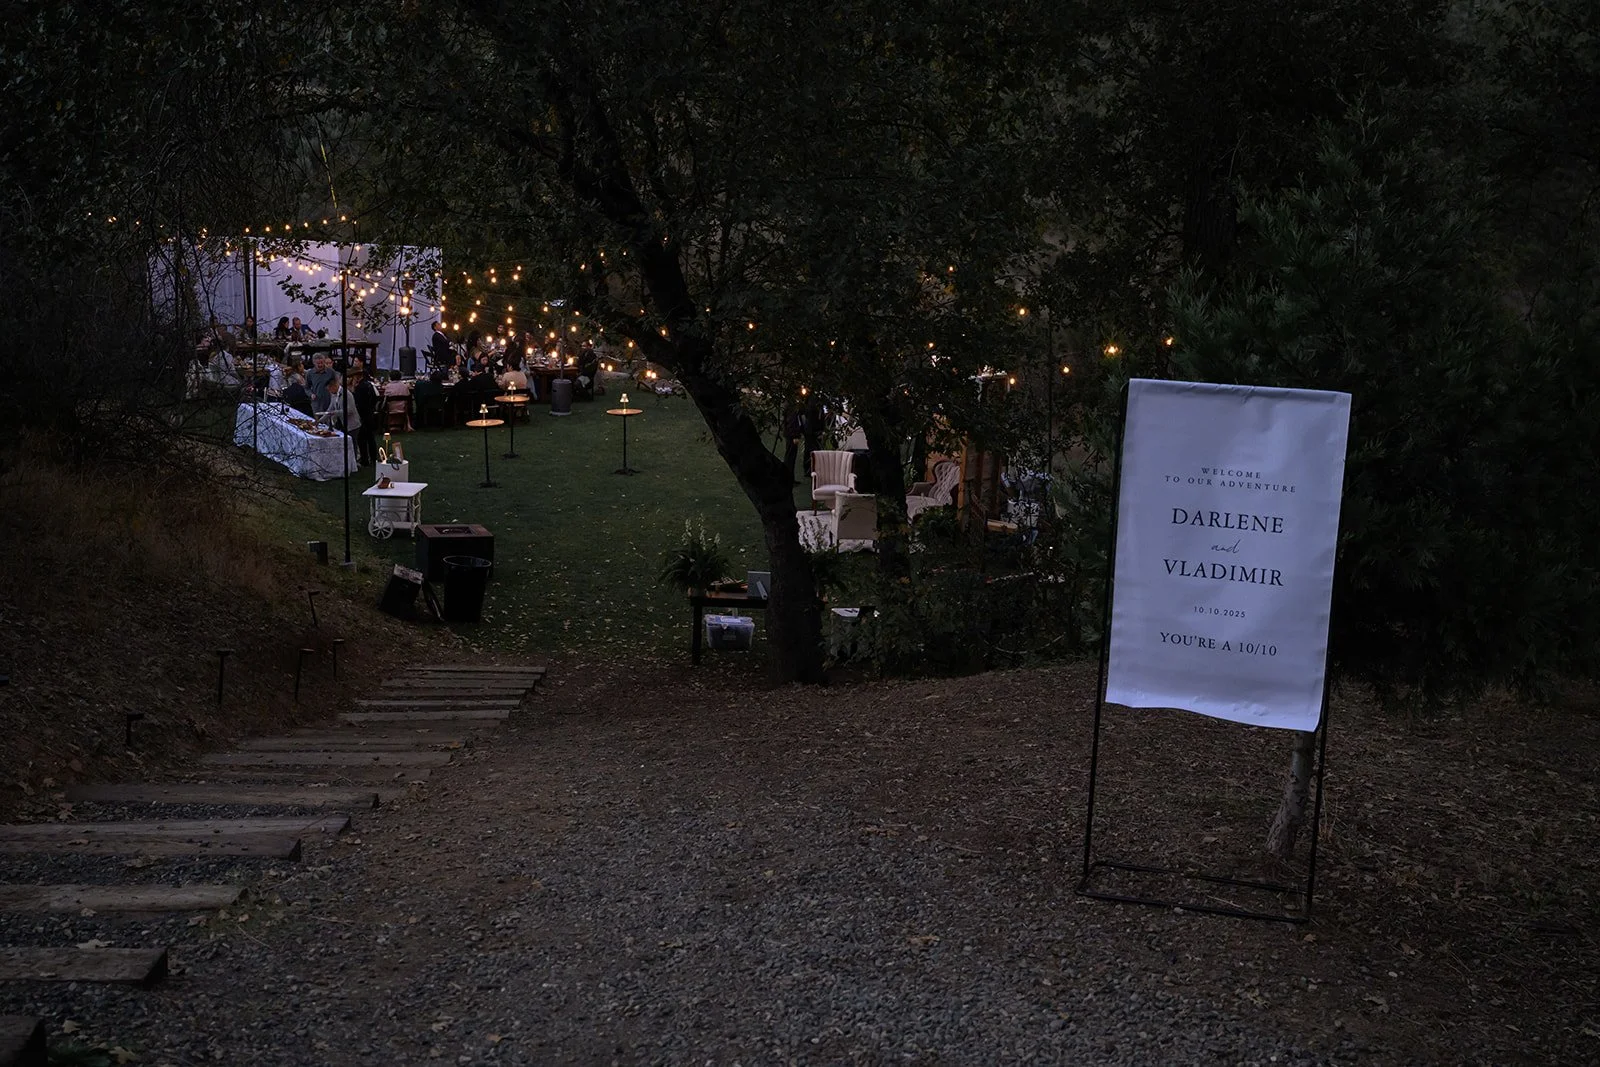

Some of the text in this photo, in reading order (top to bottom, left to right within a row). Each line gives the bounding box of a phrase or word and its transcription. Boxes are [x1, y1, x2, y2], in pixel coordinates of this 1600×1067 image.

[1201, 467, 1262, 479] WELCOME
[1165, 475, 1297, 493] TO OUR ADVENTURE
[1172, 508, 1284, 534] DARLENE
[1211, 540, 1242, 554] and
[1163, 559, 1284, 587] VLADIMIR
[1194, 606, 1247, 618] 10.10.2025
[1160, 632, 1278, 657] YOU'RE A 10/10
